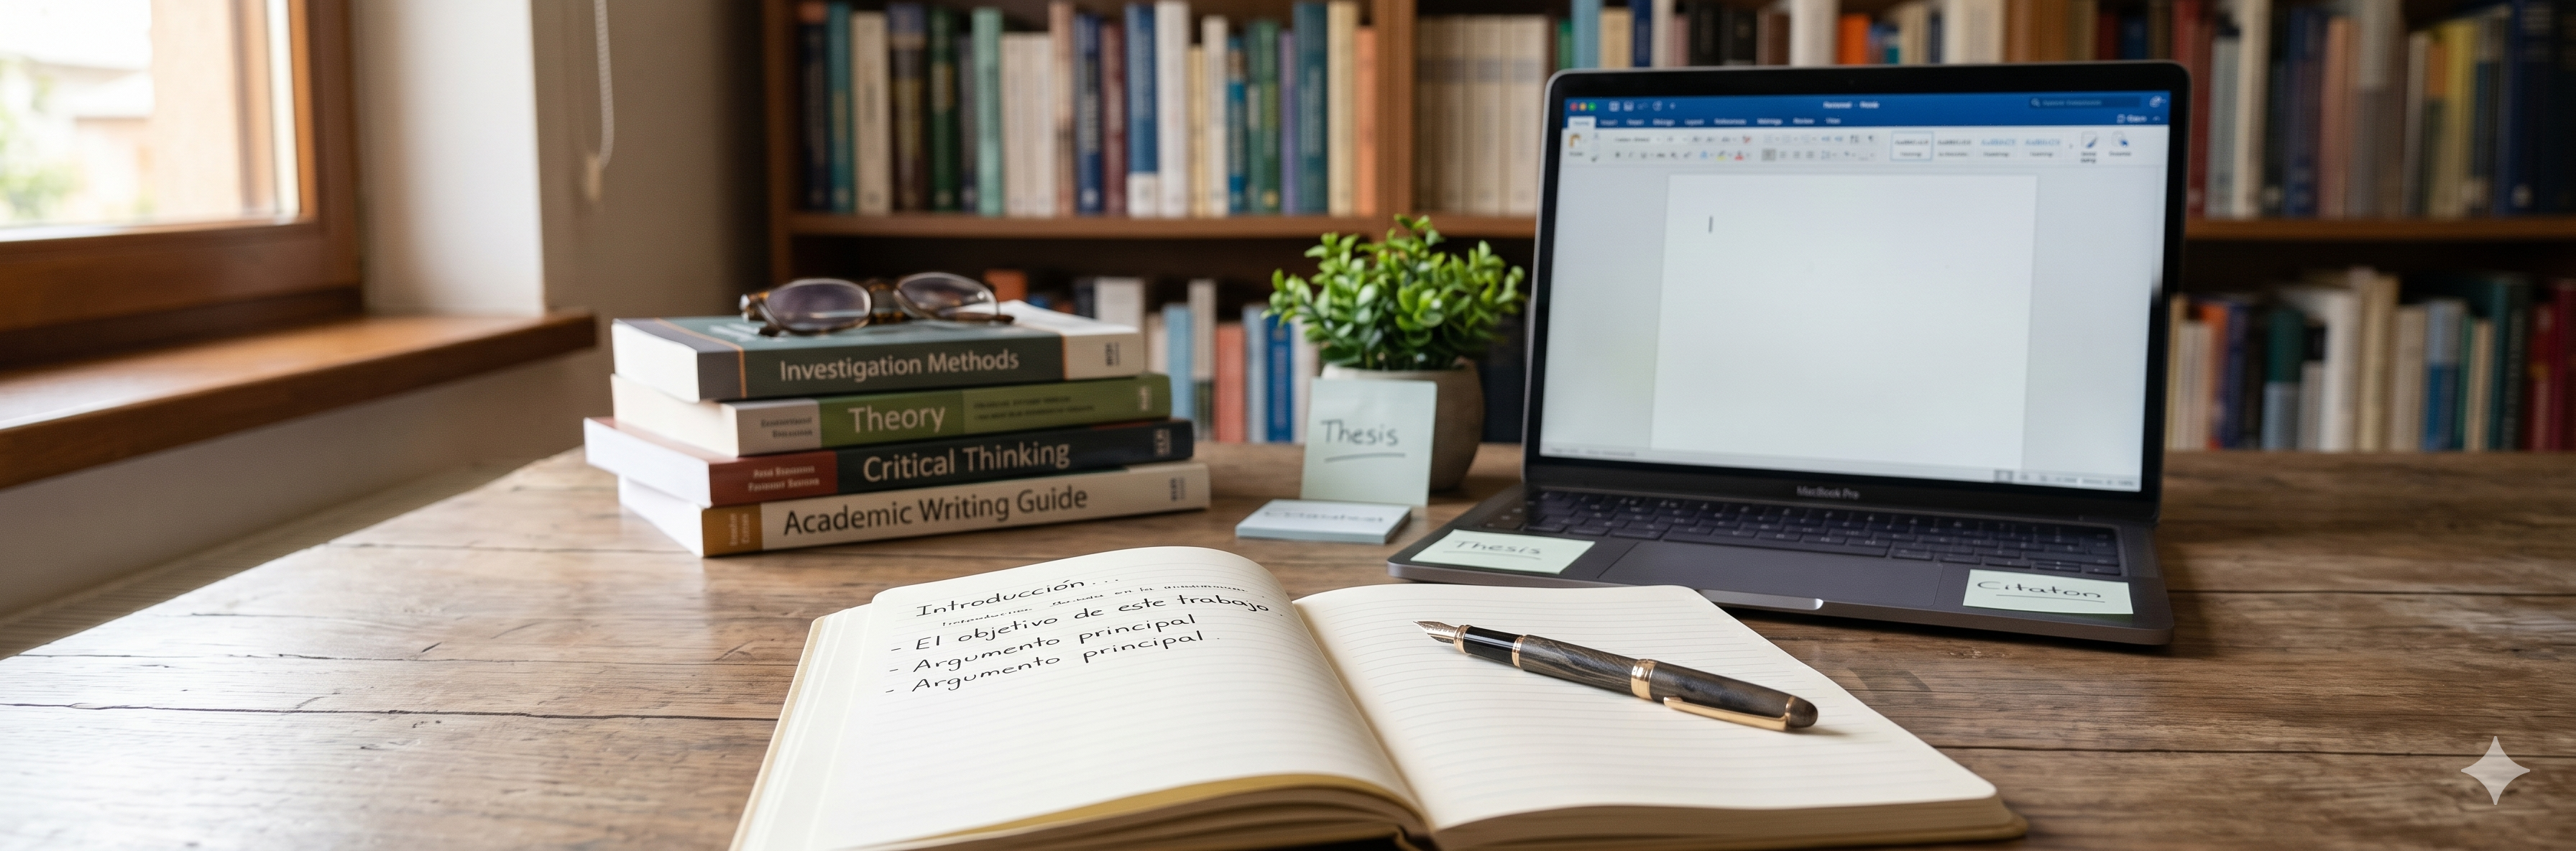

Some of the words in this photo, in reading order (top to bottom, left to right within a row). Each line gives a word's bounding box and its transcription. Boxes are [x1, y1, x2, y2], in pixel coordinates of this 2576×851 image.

[780, 355, 922, 382] Investigation
[928, 349, 1019, 374] Methods
[847, 404, 946, 433] Theory
[1320, 418, 1399, 446] Thesis
[863, 448, 955, 482] Critical
[962, 441, 1071, 469] Thinking
[783, 502, 913, 536] Academic
[918, 494, 1010, 522] Writing
[1017, 485, 1087, 513] Guide
[1797, 485, 1841, 499] MacBook
[1842, 487, 1860, 500] Pro
[1455, 540, 1541, 555] Thesis
[916, 580, 1085, 617] Introducción
[916, 636, 940, 650] El
[958, 619, 1058, 641] objetivo
[1075, 608, 1104, 620] de
[1118, 598, 1166, 612] este
[1177, 594, 1269, 612] trabajo
[911, 657, 1059, 691] Argumento
[1083, 630, 1203, 663] principal
[913, 637, 1059, 672] Argumento
[1079, 615, 1195, 645] principal
